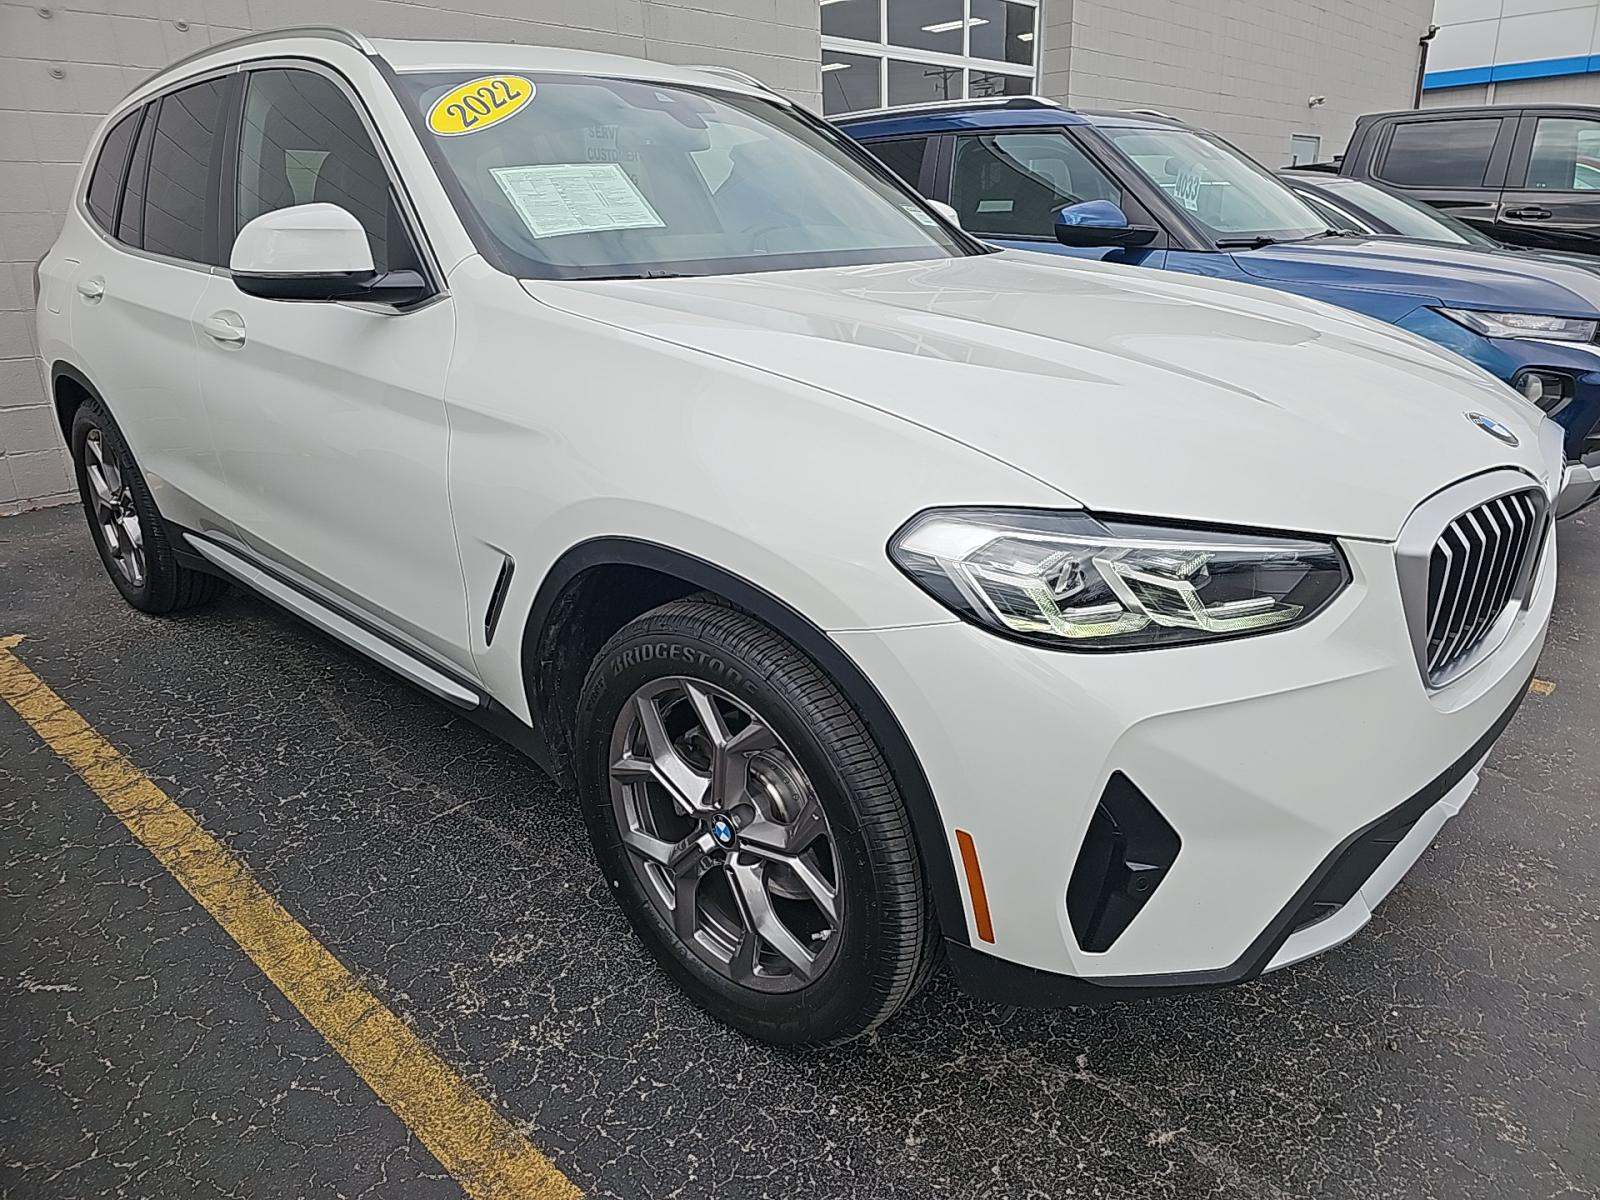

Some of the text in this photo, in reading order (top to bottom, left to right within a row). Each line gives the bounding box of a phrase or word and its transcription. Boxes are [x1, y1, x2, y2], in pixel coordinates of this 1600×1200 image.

[446, 80, 521, 128] 2022
[587, 147, 640, 161] CUSTOER
[1175, 173, 1199, 200] 4033
[610, 642, 760, 695] BRIDGESTONE
